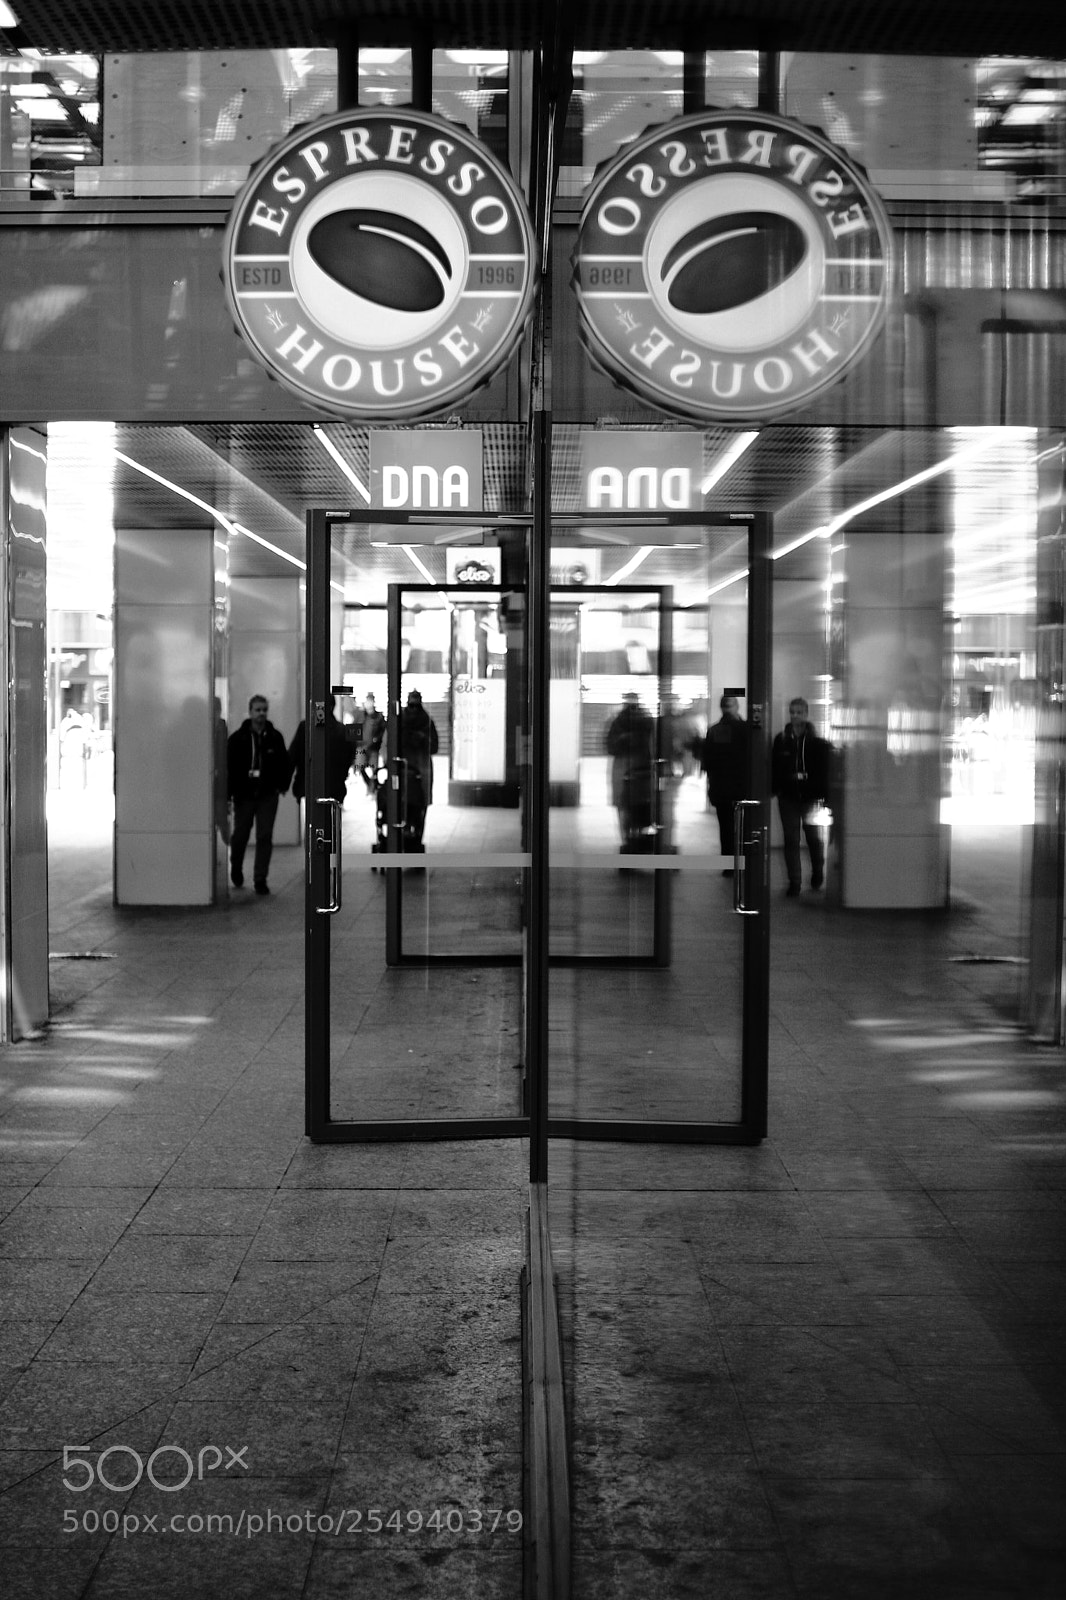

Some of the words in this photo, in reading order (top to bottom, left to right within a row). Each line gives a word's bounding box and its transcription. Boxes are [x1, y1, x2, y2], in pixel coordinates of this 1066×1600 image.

[248, 125, 509, 237] ESPRESSO
[242, 268, 282, 285] ESTD
[478, 267, 515, 285] 1996
[275, 325, 481, 396] HOUSE
[382, 465, 469, 508] DNA
